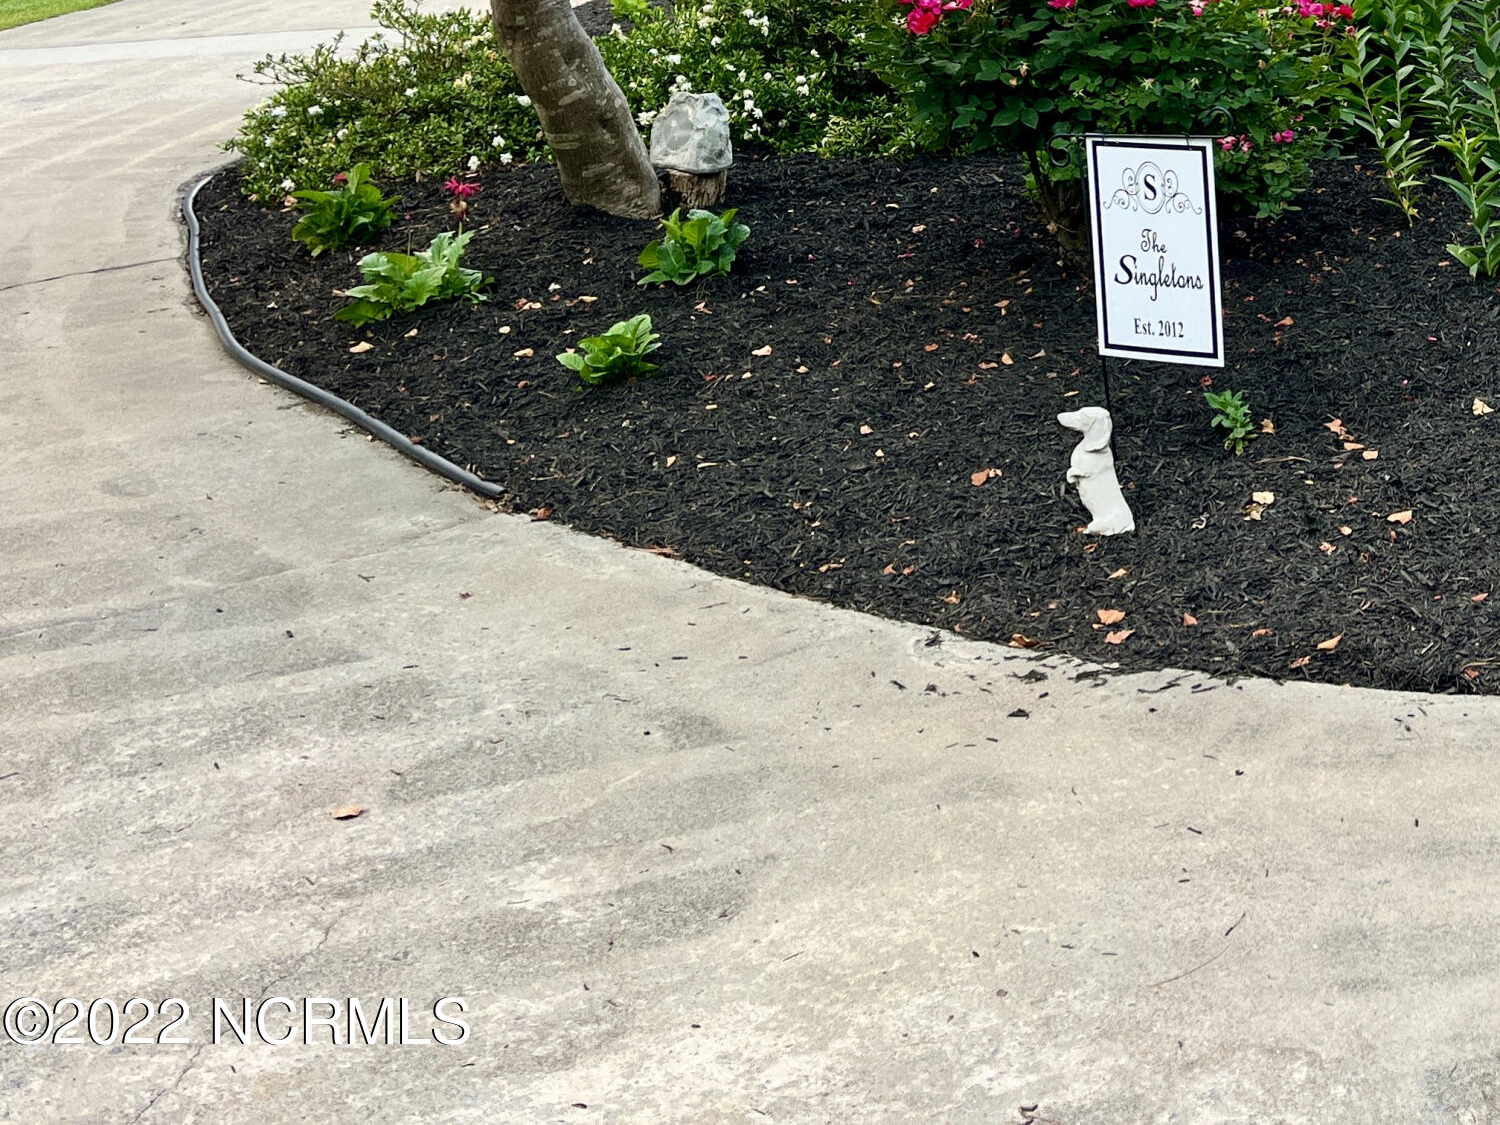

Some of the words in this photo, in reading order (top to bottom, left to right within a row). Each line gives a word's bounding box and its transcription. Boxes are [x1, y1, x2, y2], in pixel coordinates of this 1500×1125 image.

[1144, 173, 1158, 201] S
[1140, 228, 1168, 254] The
[1114, 254, 1204, 302] Singletons
[1133, 317, 1156, 336] Est.
[1158, 320, 1184, 338] 2012
